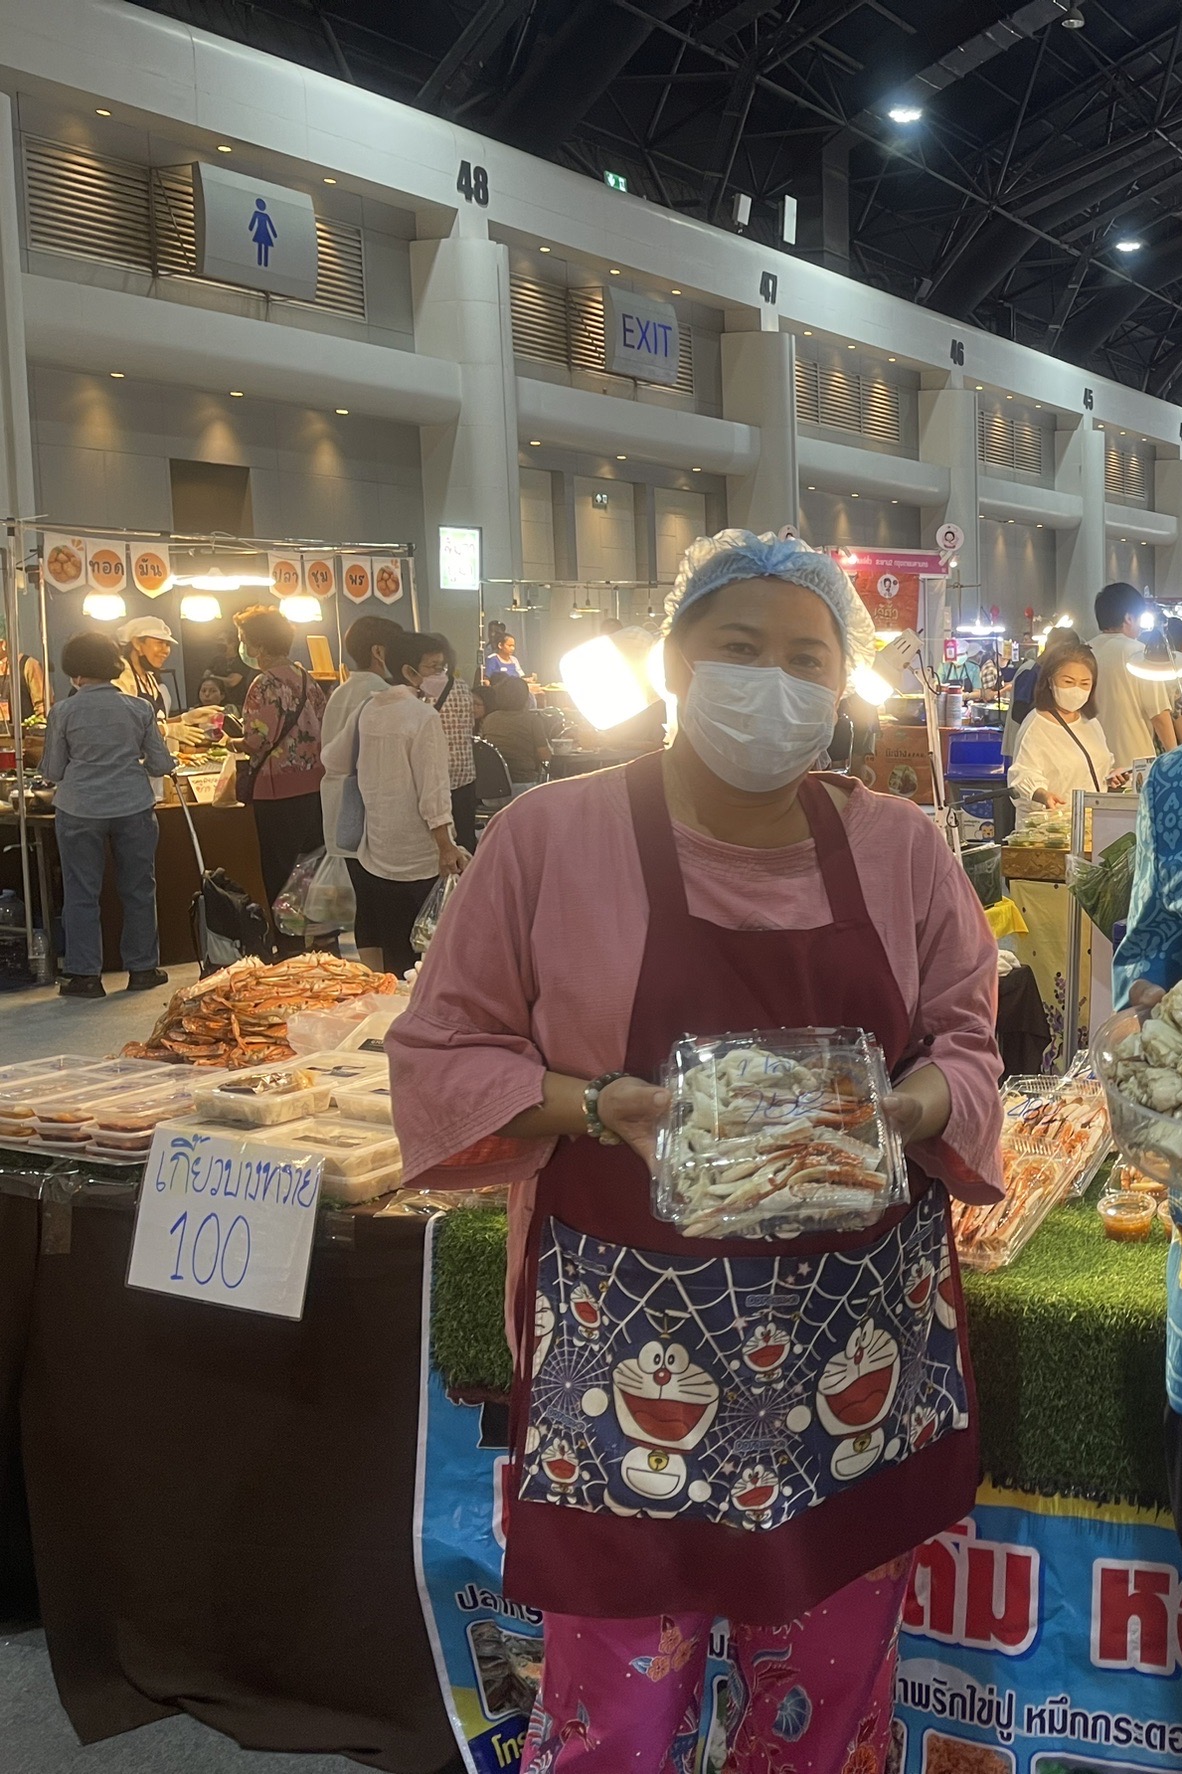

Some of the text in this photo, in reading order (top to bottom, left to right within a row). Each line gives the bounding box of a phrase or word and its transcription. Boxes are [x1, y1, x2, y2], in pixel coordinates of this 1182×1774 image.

[457, 160, 489, 208] 48
[759, 271, 778, 305] 47
[622, 313, 672, 358] EXIT
[950, 339, 965, 366] 46
[1083, 388, 1094, 411] 45
[88, 559, 124, 576] ทอด
[272, 566, 298, 584] ปลา
[310, 569, 329, 590] ชุม
[349, 573, 365, 587] พร
[169, 1211, 251, 1289] 100
